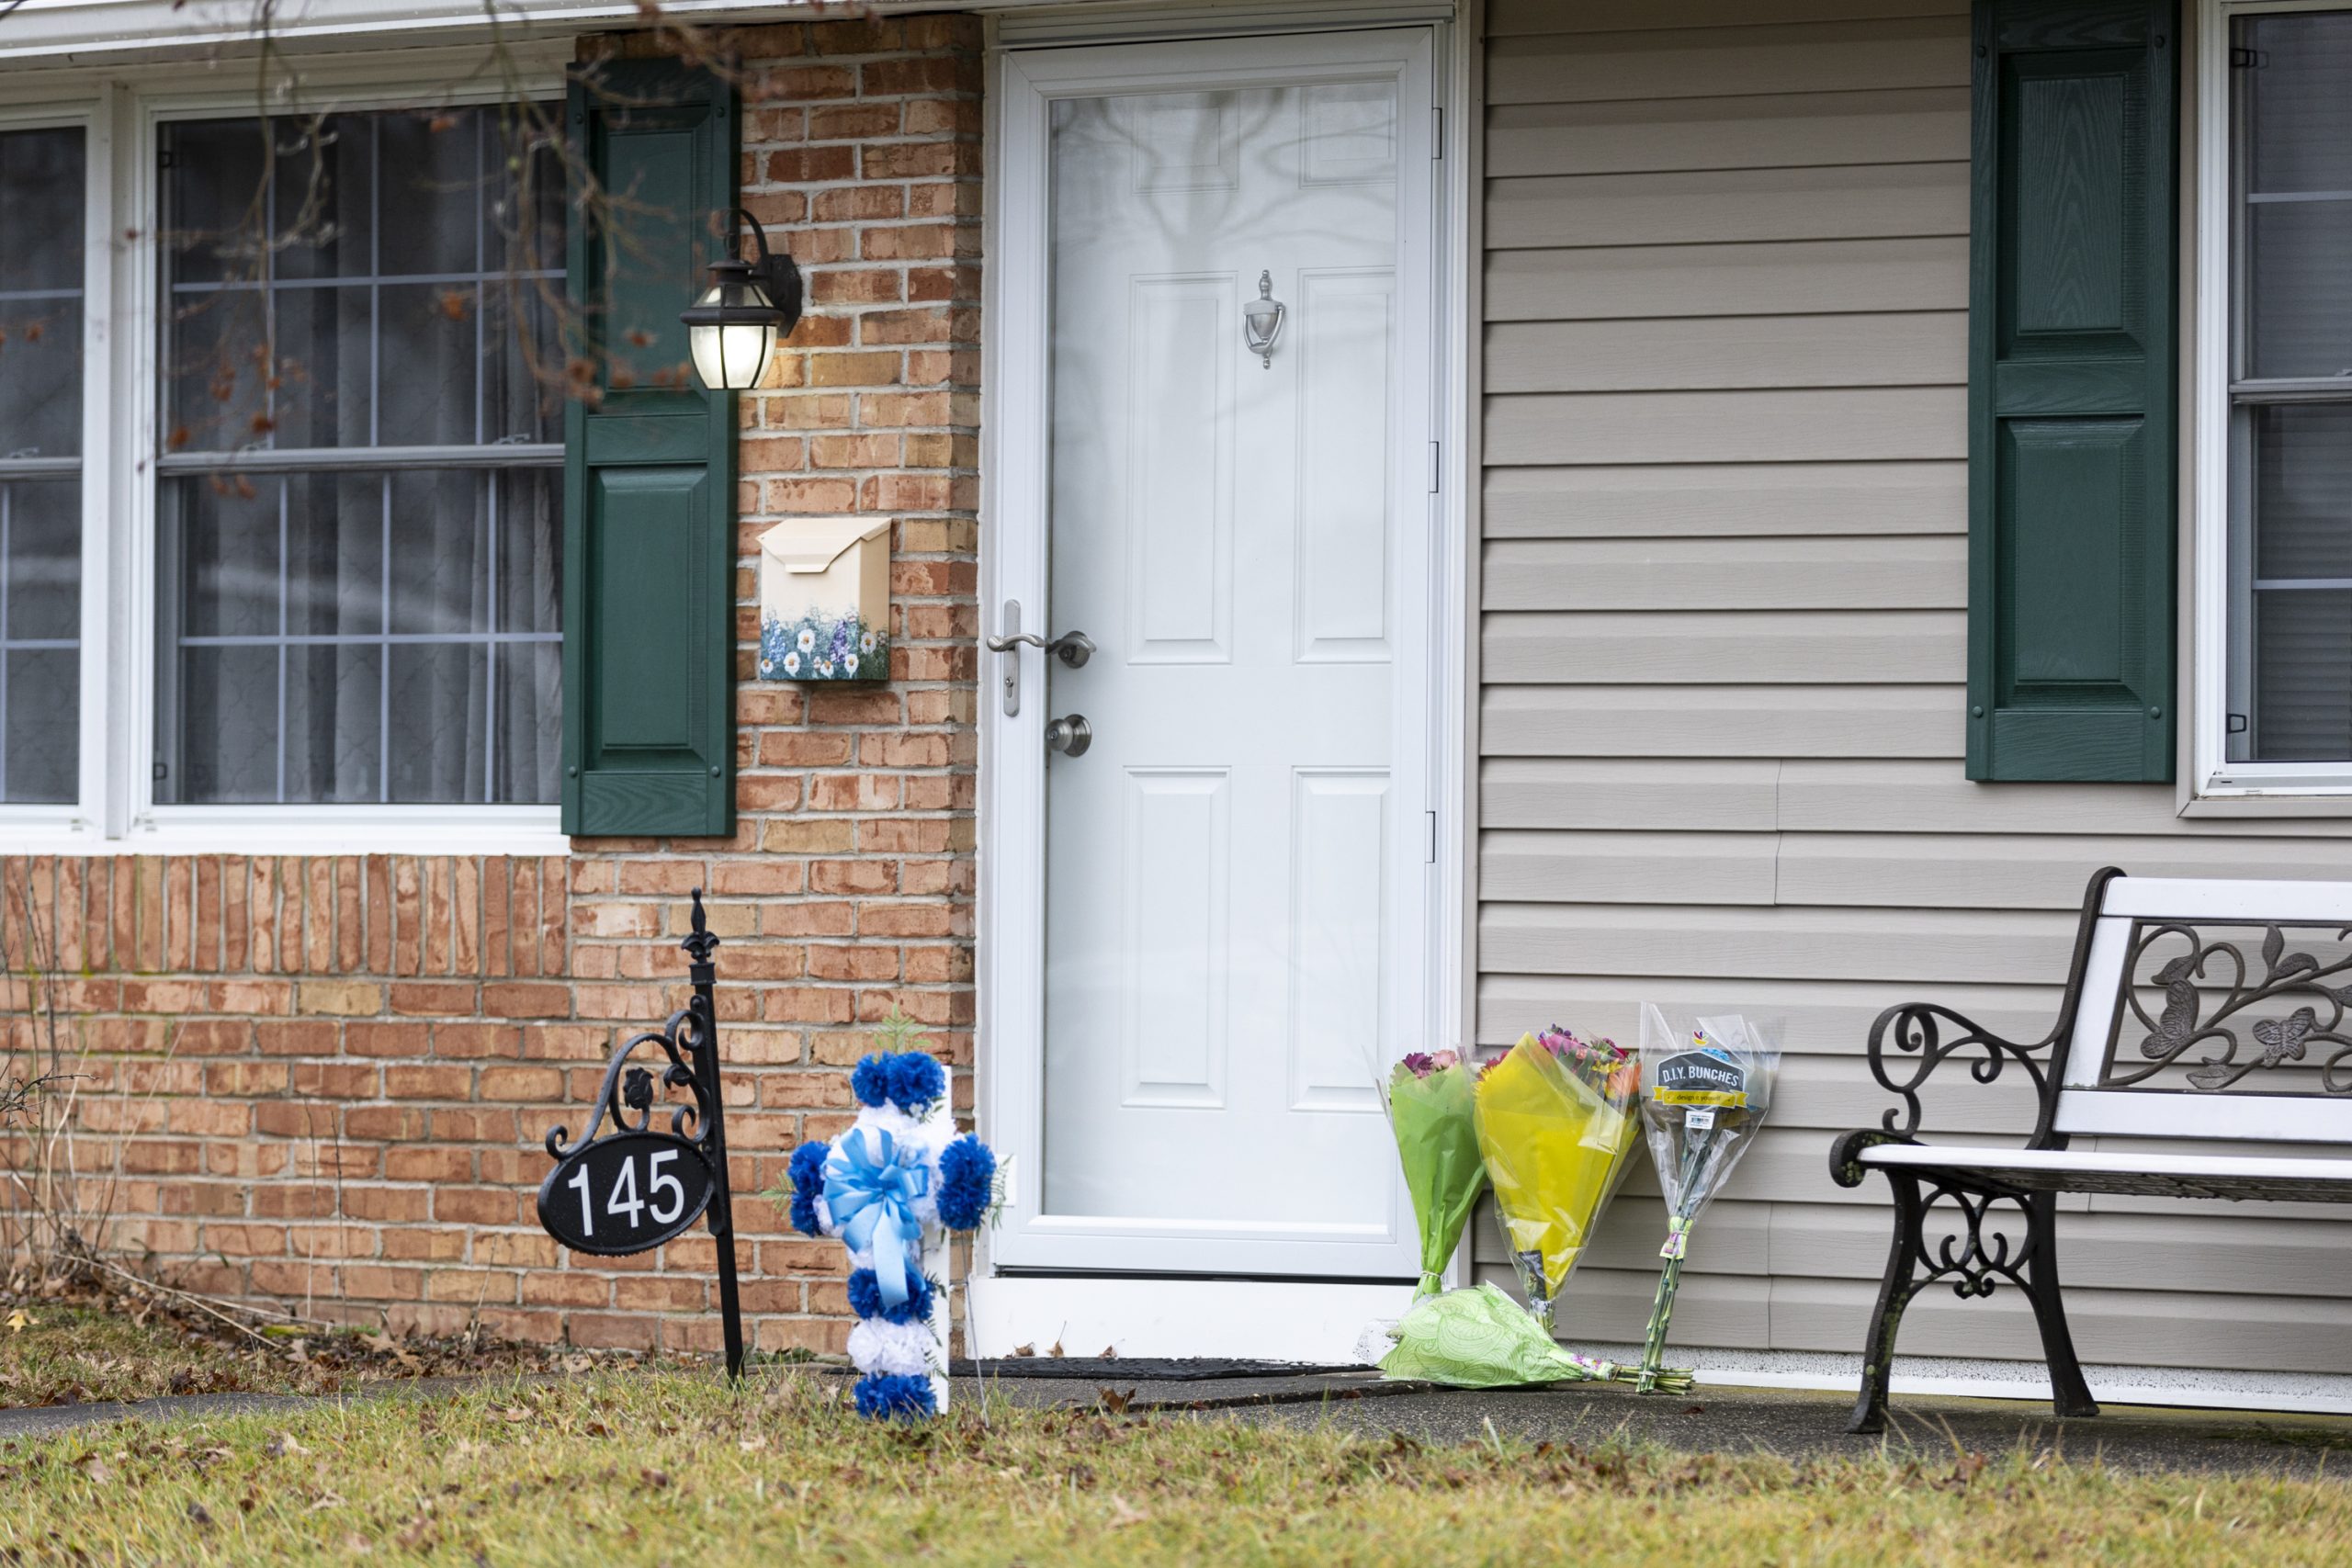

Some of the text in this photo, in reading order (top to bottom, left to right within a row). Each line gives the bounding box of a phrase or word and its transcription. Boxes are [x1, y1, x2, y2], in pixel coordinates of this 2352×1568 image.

[1662, 1066, 1739, 1087] D.I.Y. BUNCHES
[568, 1149, 685, 1237] 145
